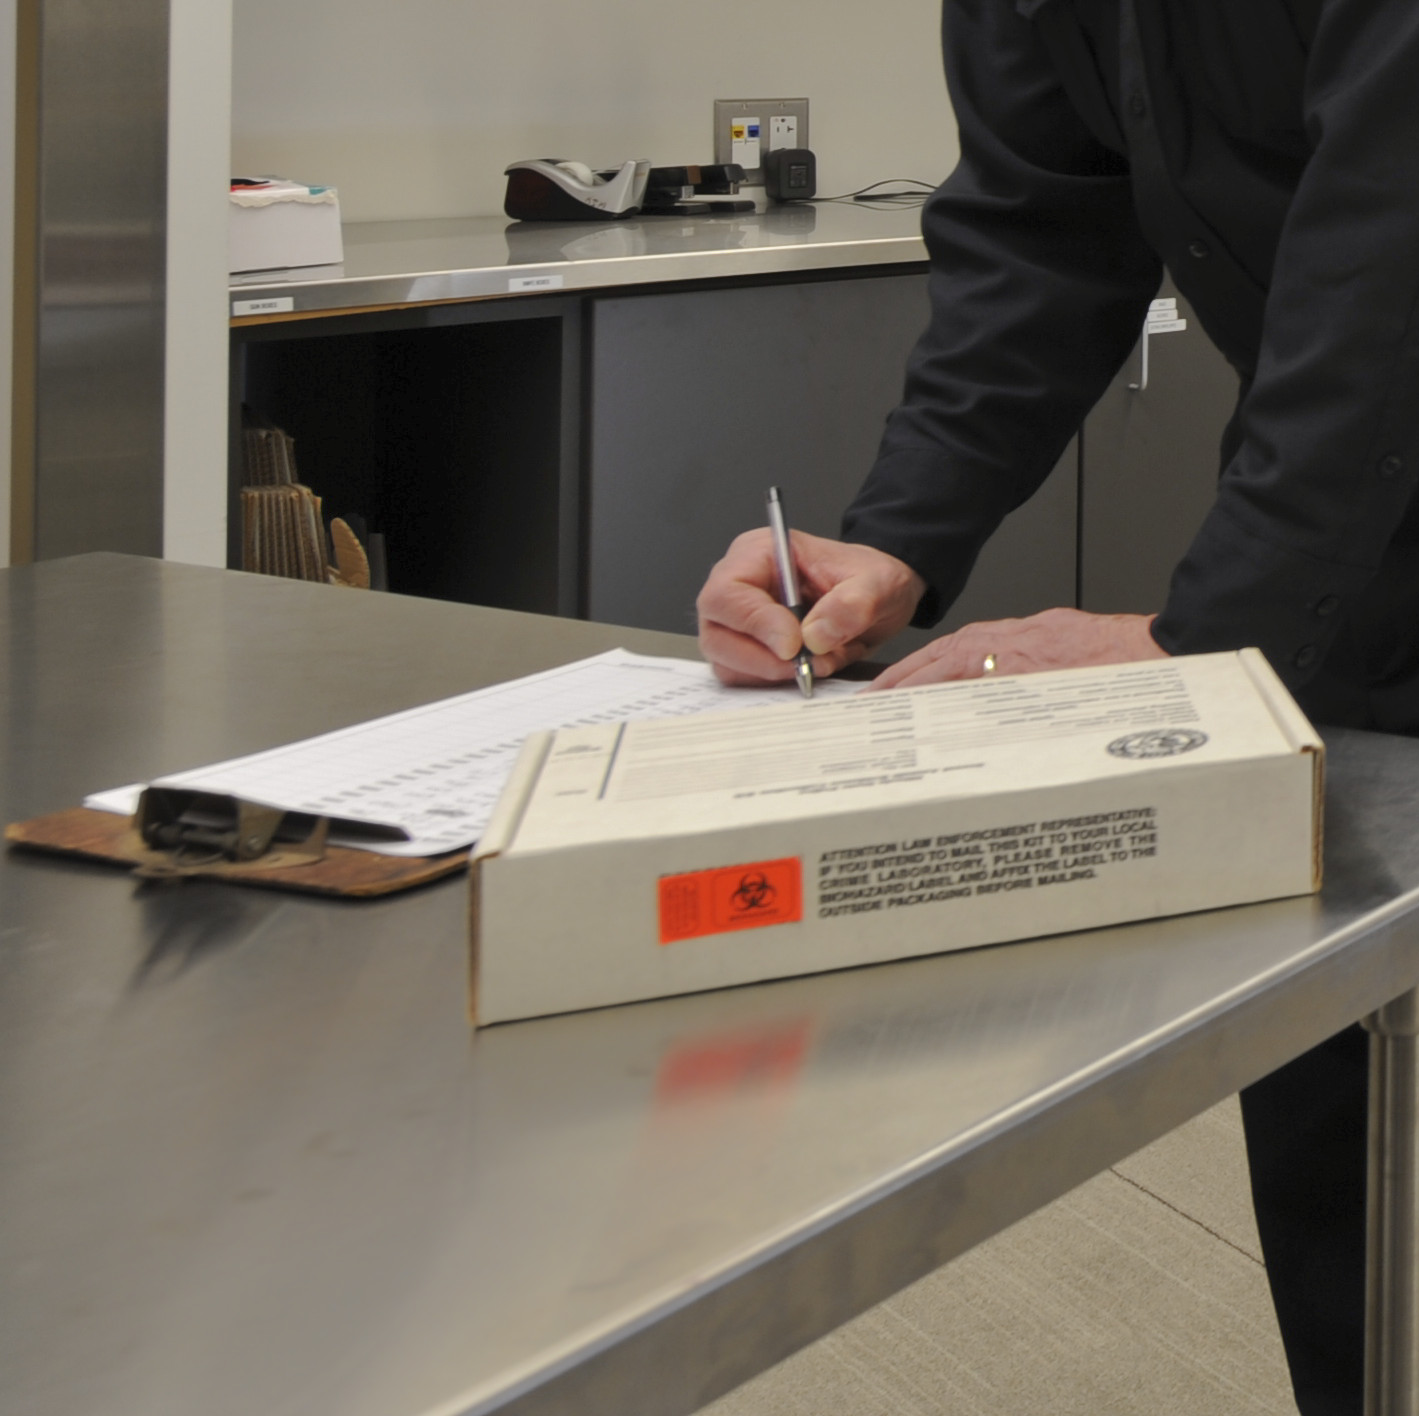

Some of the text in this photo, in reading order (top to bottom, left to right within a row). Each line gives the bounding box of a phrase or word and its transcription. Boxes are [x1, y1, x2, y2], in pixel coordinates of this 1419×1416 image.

[819, 843, 897, 863] ATTENTION
[902, 838, 932, 851] LAW
[936, 823, 1037, 846] ENFORCEMENT
[819, 874, 869, 891] CRIME
[994, 848, 1053, 865] PLEASE
[1060, 838, 1122, 856] REMOVE
[1129, 833, 1157, 845] THE
[820, 820, 1157, 876] IF YOU INTEND TO MAIL THIS KIT TO YOUR LOCAL
[819, 900, 882, 919] OUTSIDE
[887, 887, 972, 908] PACKAGING
[976, 878, 1033, 895] BEFORE
[820, 846, 1157, 905] BIOHAZARD LABEL AND AFFIX THE LABEL TO THE
